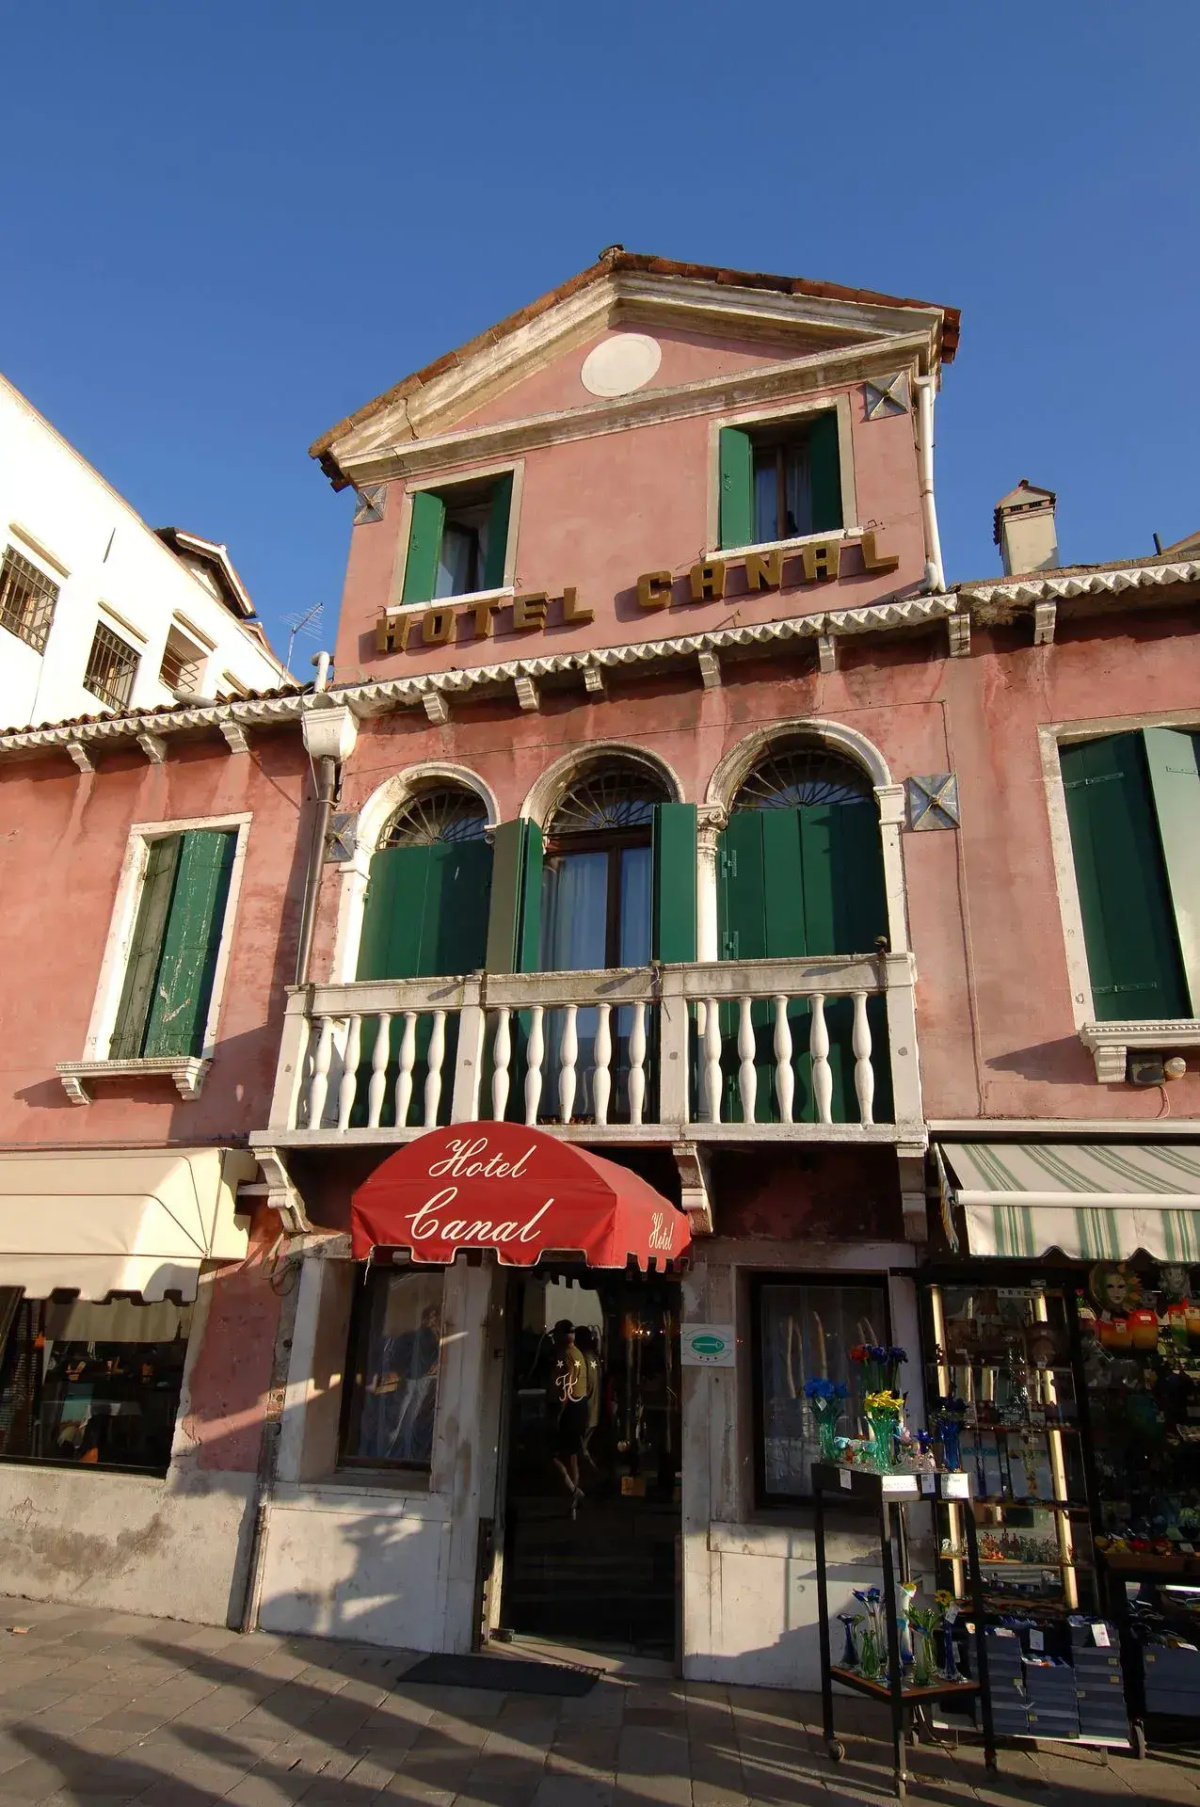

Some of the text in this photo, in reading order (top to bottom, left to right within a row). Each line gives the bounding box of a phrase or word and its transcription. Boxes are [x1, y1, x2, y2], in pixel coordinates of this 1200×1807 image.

[376, 531, 900, 653] HOTEL CANAL
[429, 1137, 537, 1178] Hotel
[405, 1187, 554, 1242] Canal
[649, 1212, 674, 1250] Hotel
